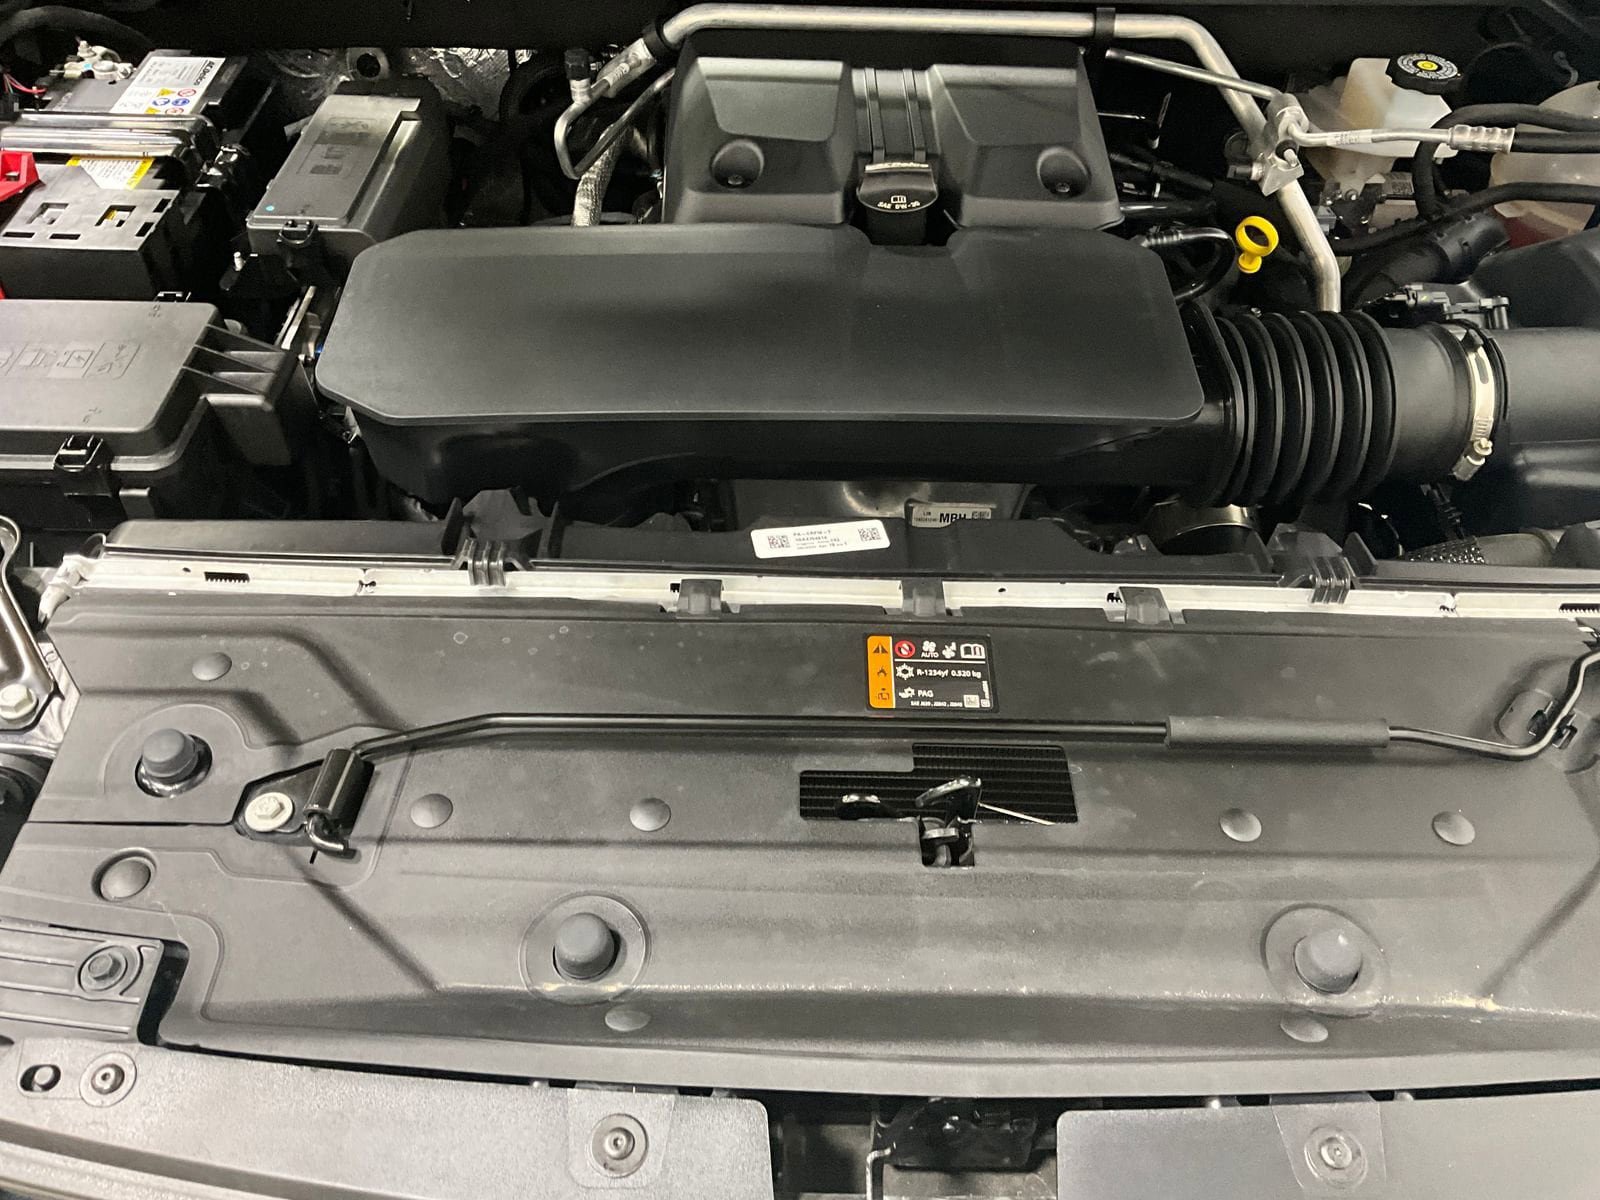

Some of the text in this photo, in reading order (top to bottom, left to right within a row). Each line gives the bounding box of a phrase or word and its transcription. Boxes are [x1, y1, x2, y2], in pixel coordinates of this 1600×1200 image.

[917, 669, 982, 679] R-1234yf 0.520 kg
[917, 690, 933, 698] PAG
